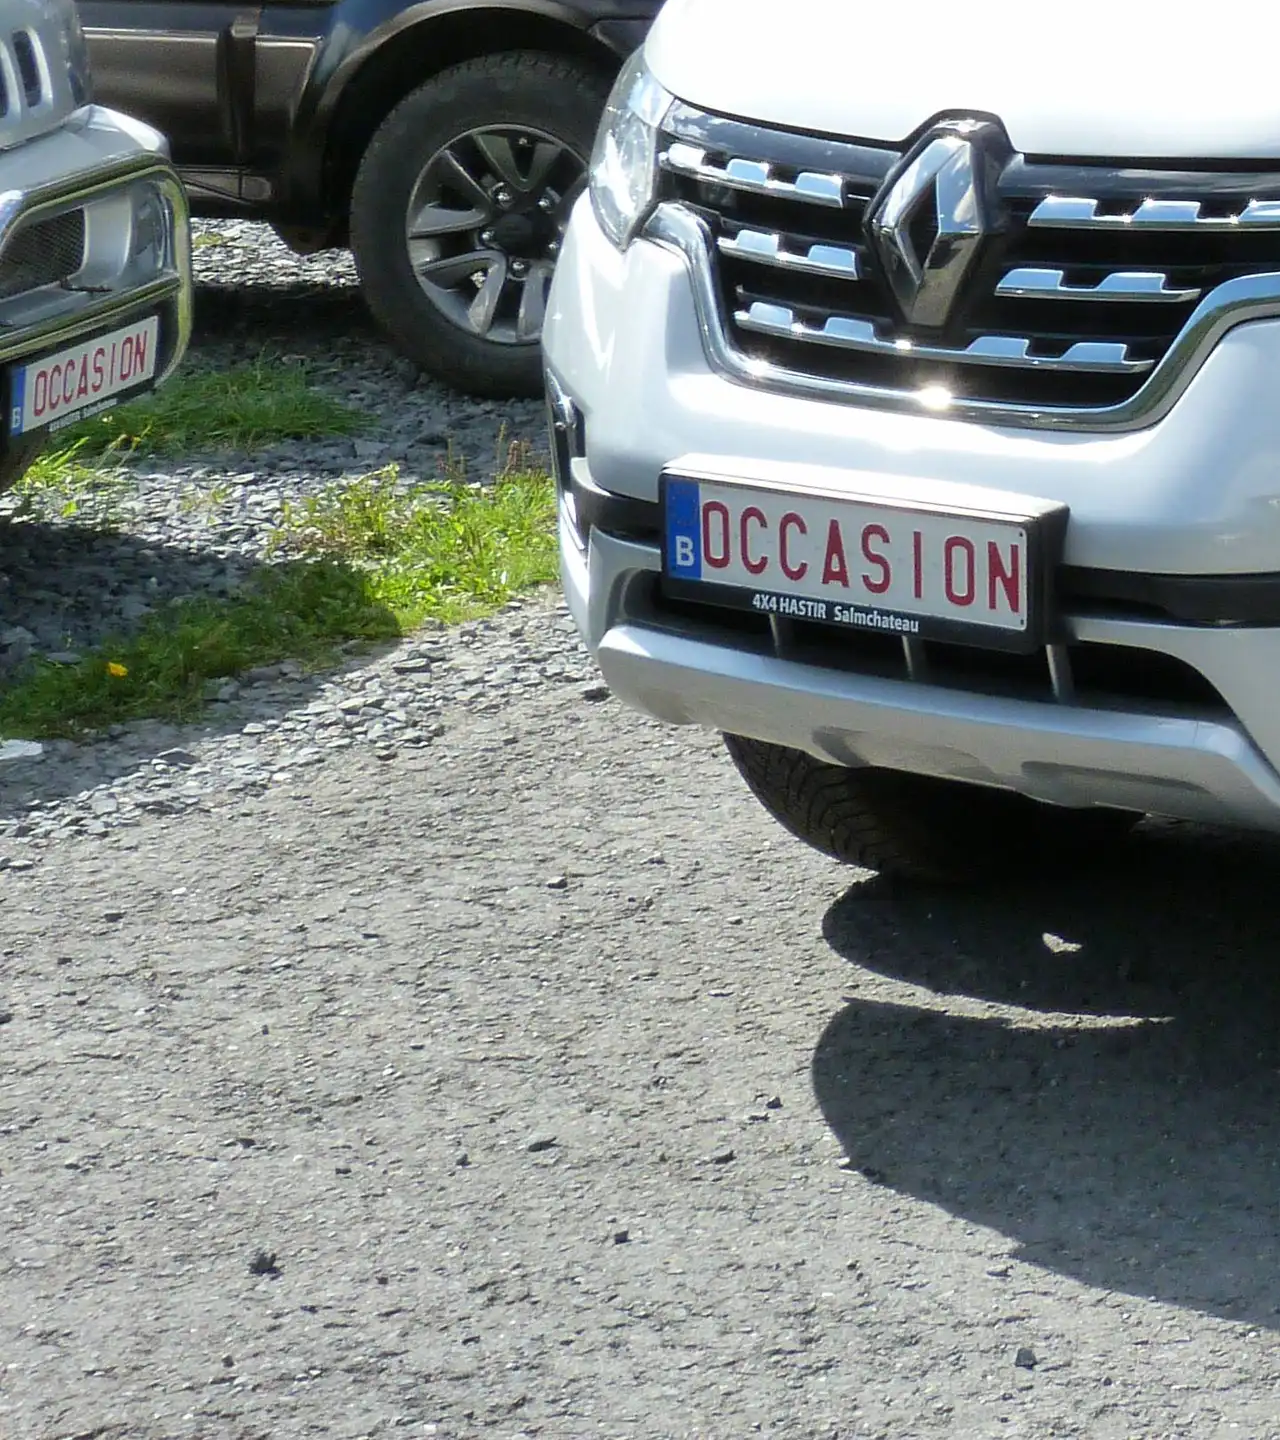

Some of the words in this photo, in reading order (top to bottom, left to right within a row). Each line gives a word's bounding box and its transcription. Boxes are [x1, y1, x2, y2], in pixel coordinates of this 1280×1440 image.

[32, 330, 148, 418] OCCASION
[675, 534, 695, 567] B
[701, 500, 1021, 614] OCCASION
[752, 593, 778, 611] 4X4
[779, 597, 827, 620] HASTIR
[833, 606, 920, 633] Salmchateau
